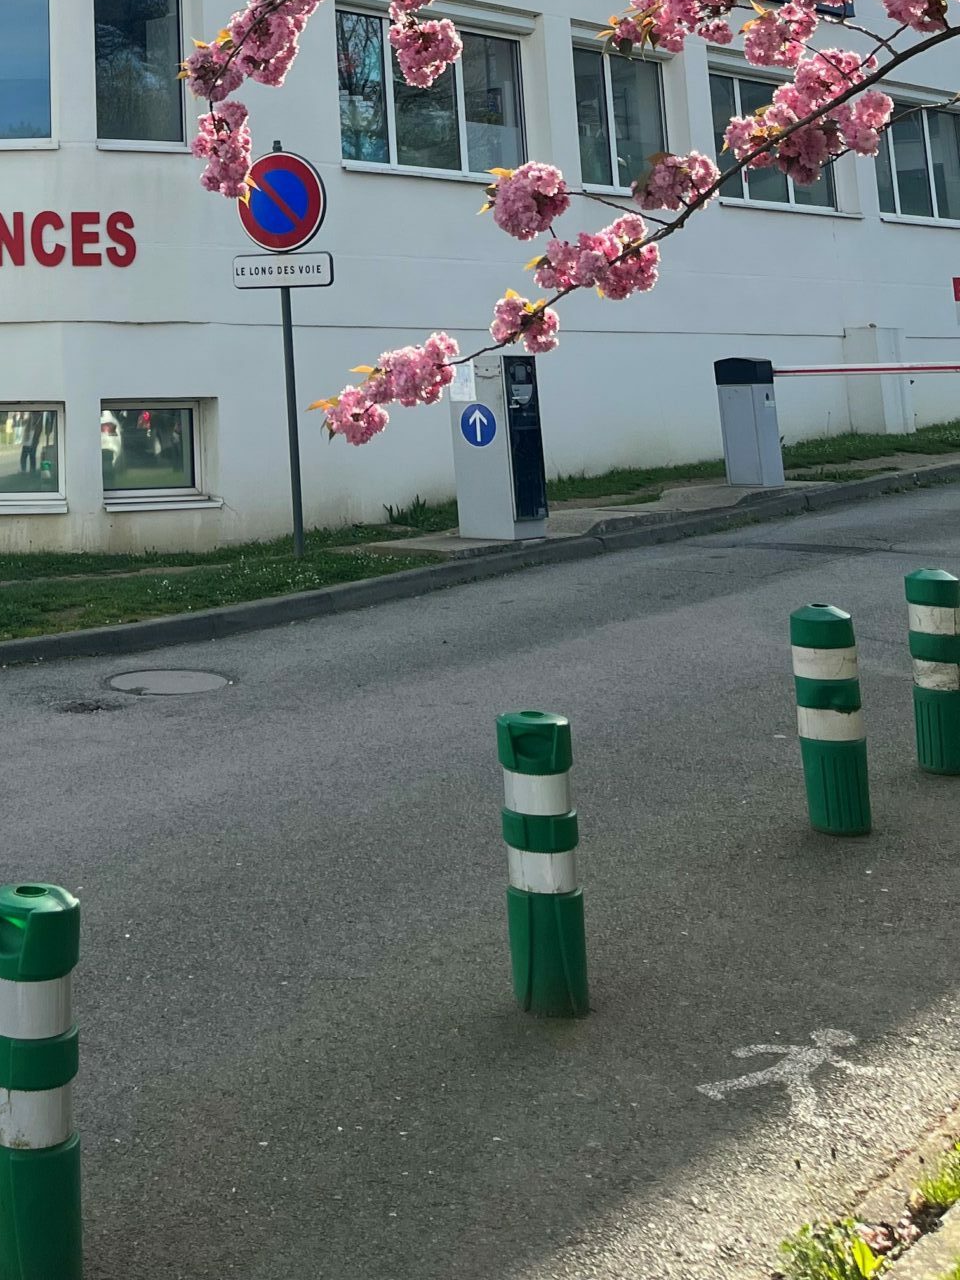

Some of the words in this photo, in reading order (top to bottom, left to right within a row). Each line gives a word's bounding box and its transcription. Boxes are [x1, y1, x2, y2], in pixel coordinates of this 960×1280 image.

[235, 267, 245, 276] LE
[249, 266, 273, 276] LONG
[277, 265, 295, 275] DES
[299, 264, 322, 274] VOIE
